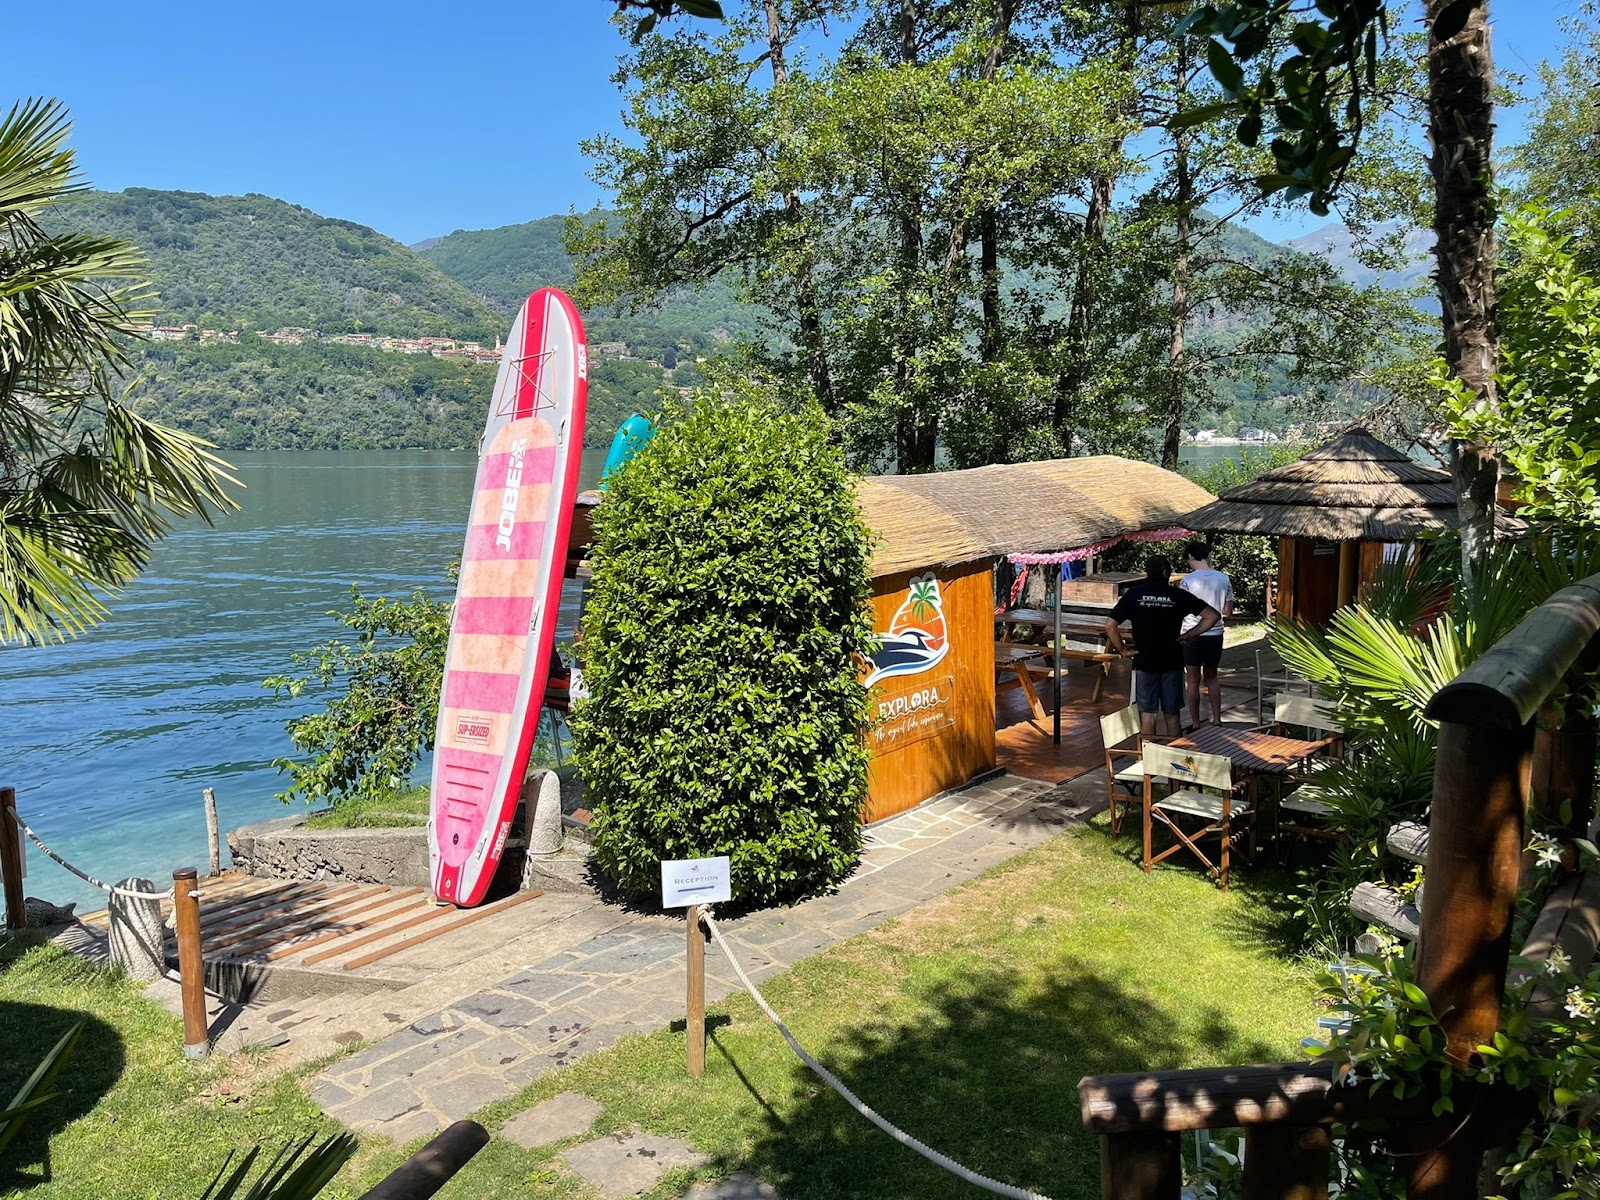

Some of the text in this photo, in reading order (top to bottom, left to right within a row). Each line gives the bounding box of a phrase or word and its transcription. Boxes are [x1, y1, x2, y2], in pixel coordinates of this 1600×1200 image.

[577, 351, 586, 382] JOBE
[496, 467, 522, 553] JOBE
[1142, 595, 1171, 603] EXPLORA
[879, 687, 938, 718] EXPLORA
[458, 723, 490, 738] SUP-ERSIZED
[490, 830, 508, 861] JOBE
[674, 875, 719, 885] RECEPTION
